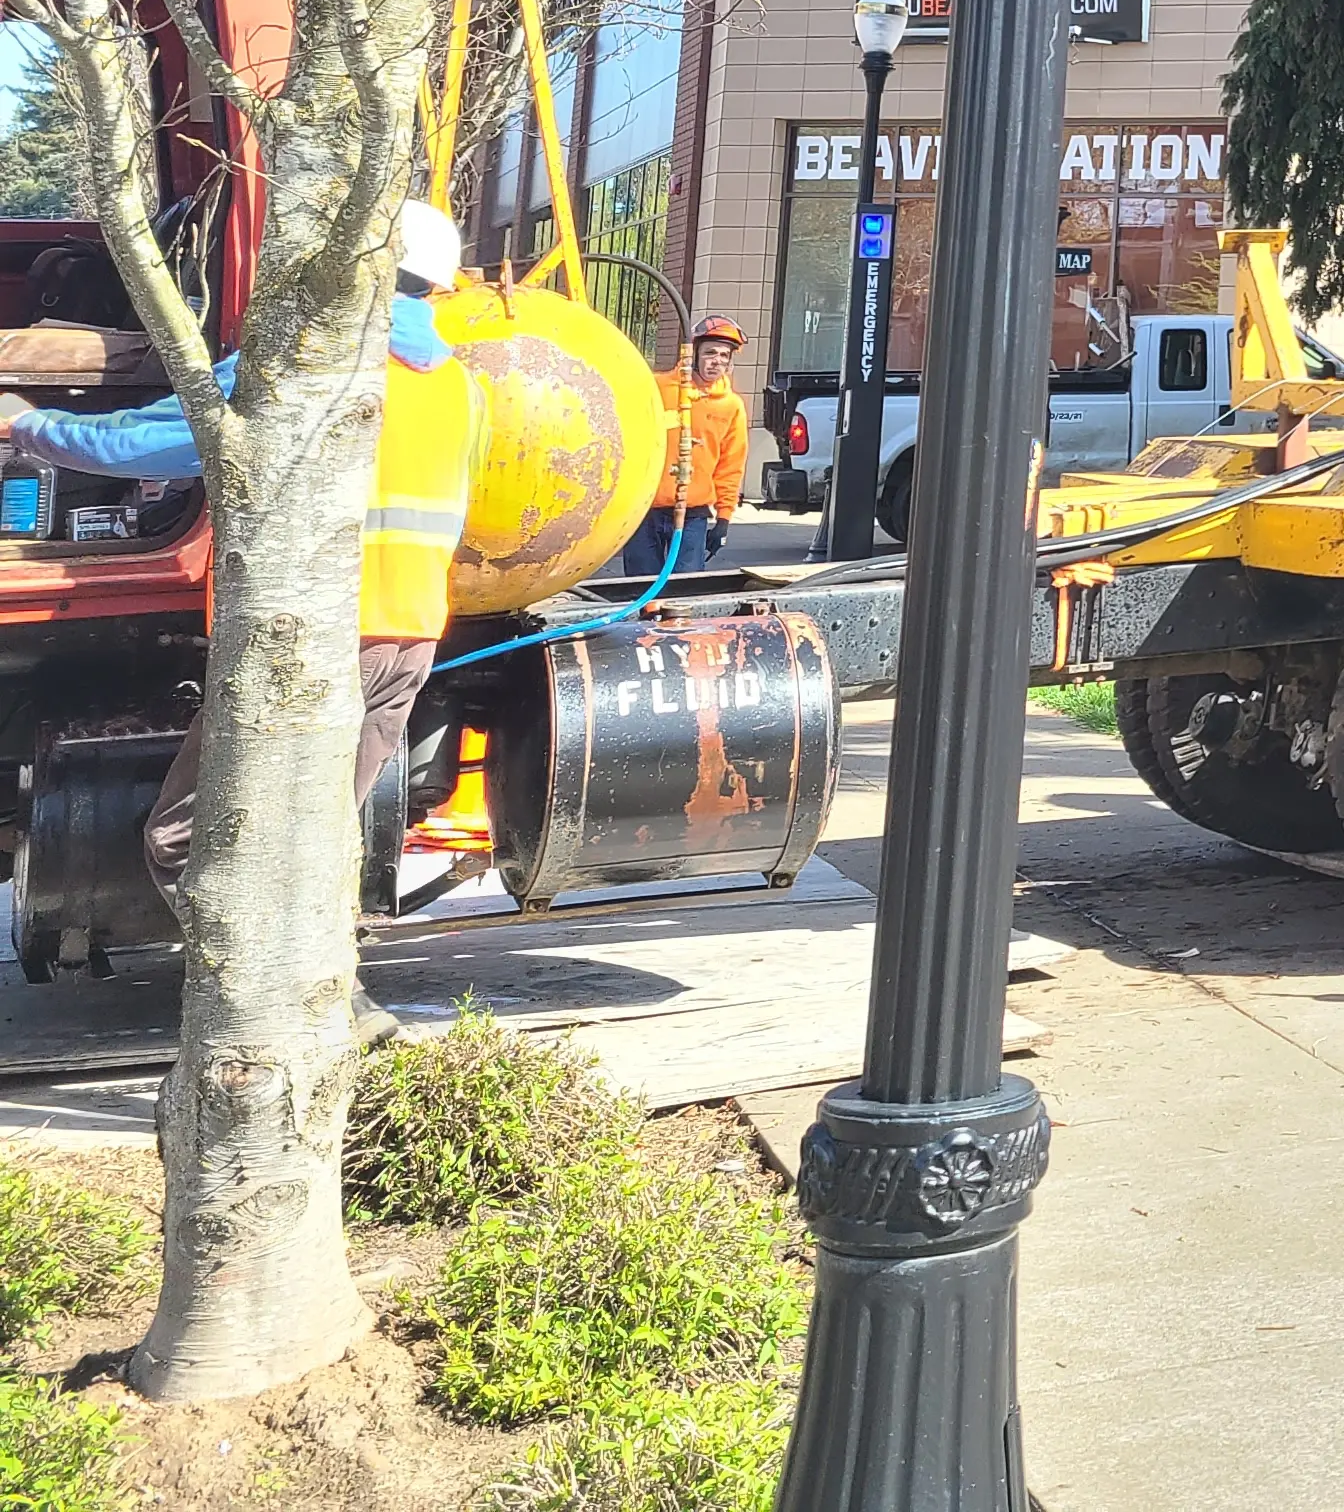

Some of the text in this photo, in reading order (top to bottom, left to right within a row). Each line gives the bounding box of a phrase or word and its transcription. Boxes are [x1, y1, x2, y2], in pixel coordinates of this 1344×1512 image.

[1058, 253, 1092, 269] MAP
[860, 261, 881, 383] EMERGENCY
[617, 671, 761, 717] FLUID
